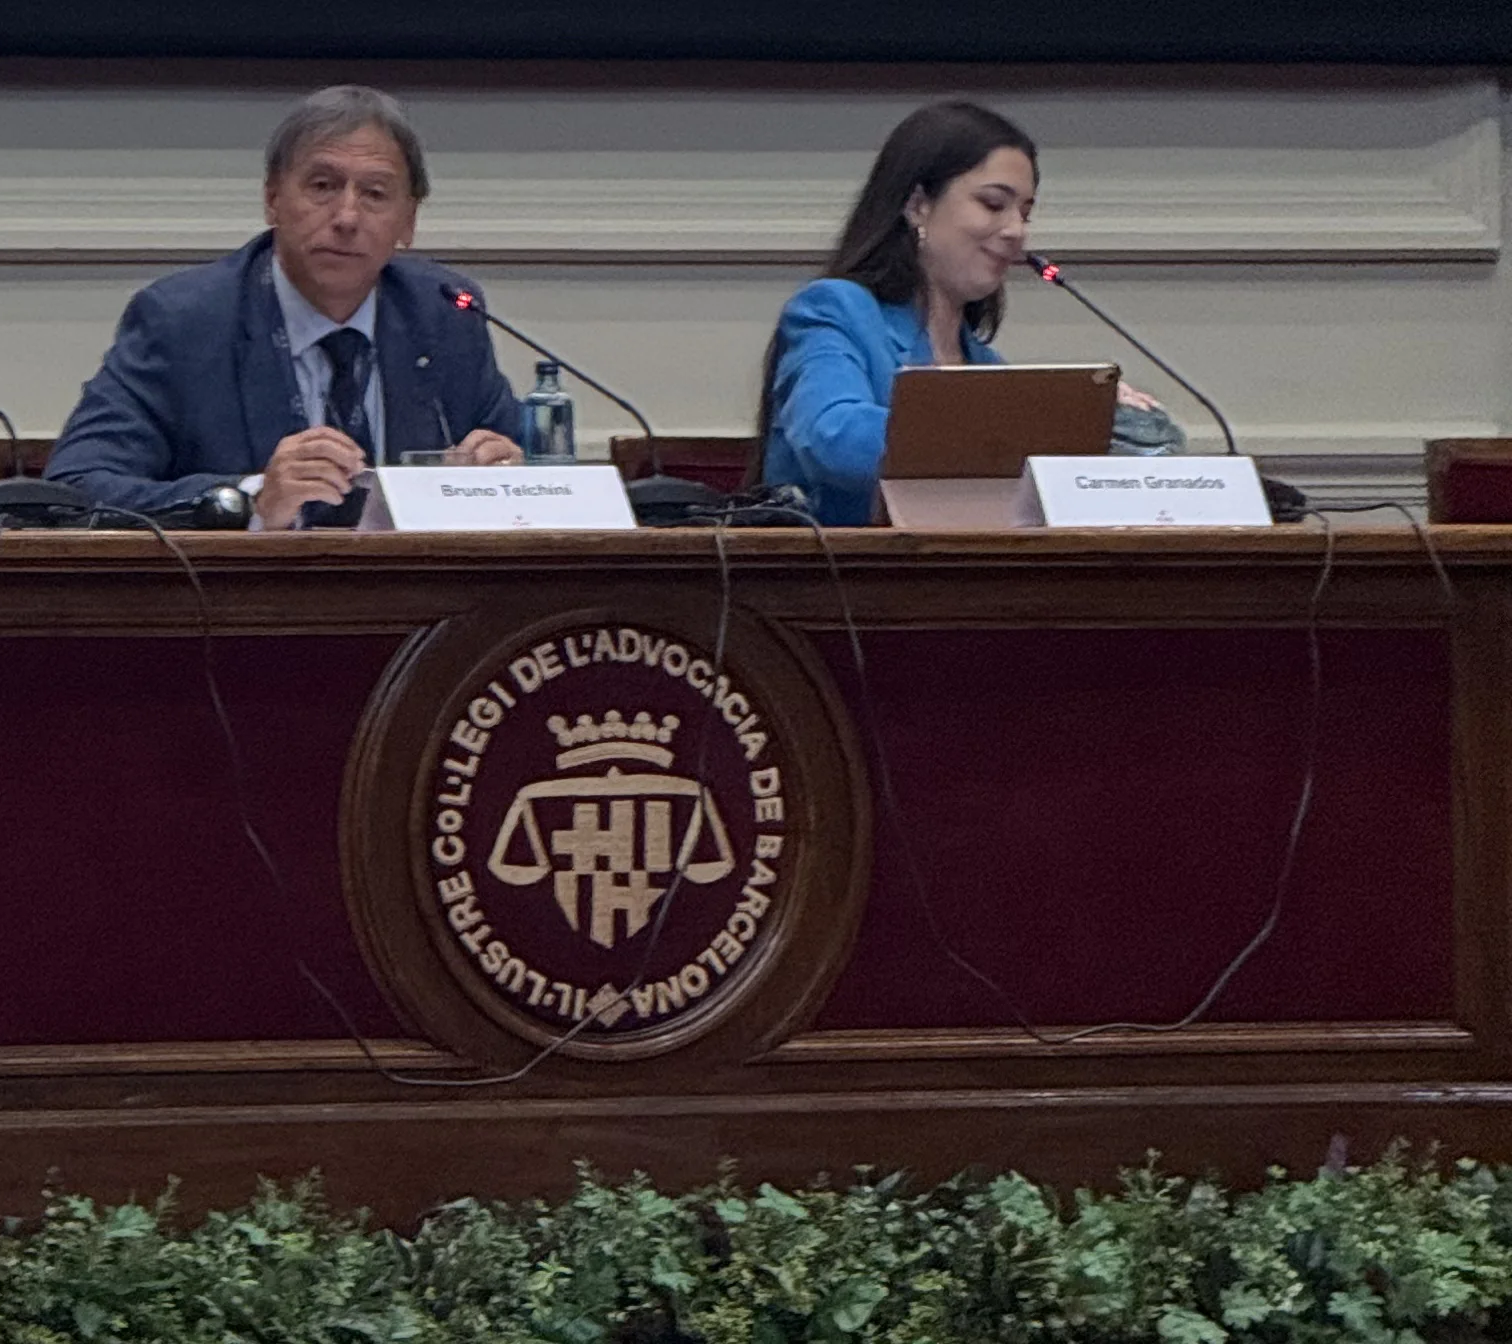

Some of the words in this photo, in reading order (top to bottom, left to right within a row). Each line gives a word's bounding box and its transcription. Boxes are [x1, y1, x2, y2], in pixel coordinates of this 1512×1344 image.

[440, 484, 498, 497] Bruno
[1074, 475, 1142, 490] Carmen
[1143, 474, 1226, 490] Granados
[509, 642, 567, 694] DE
[750, 766, 785, 823] DE
[630, 833, 785, 1020] BARCELONA
